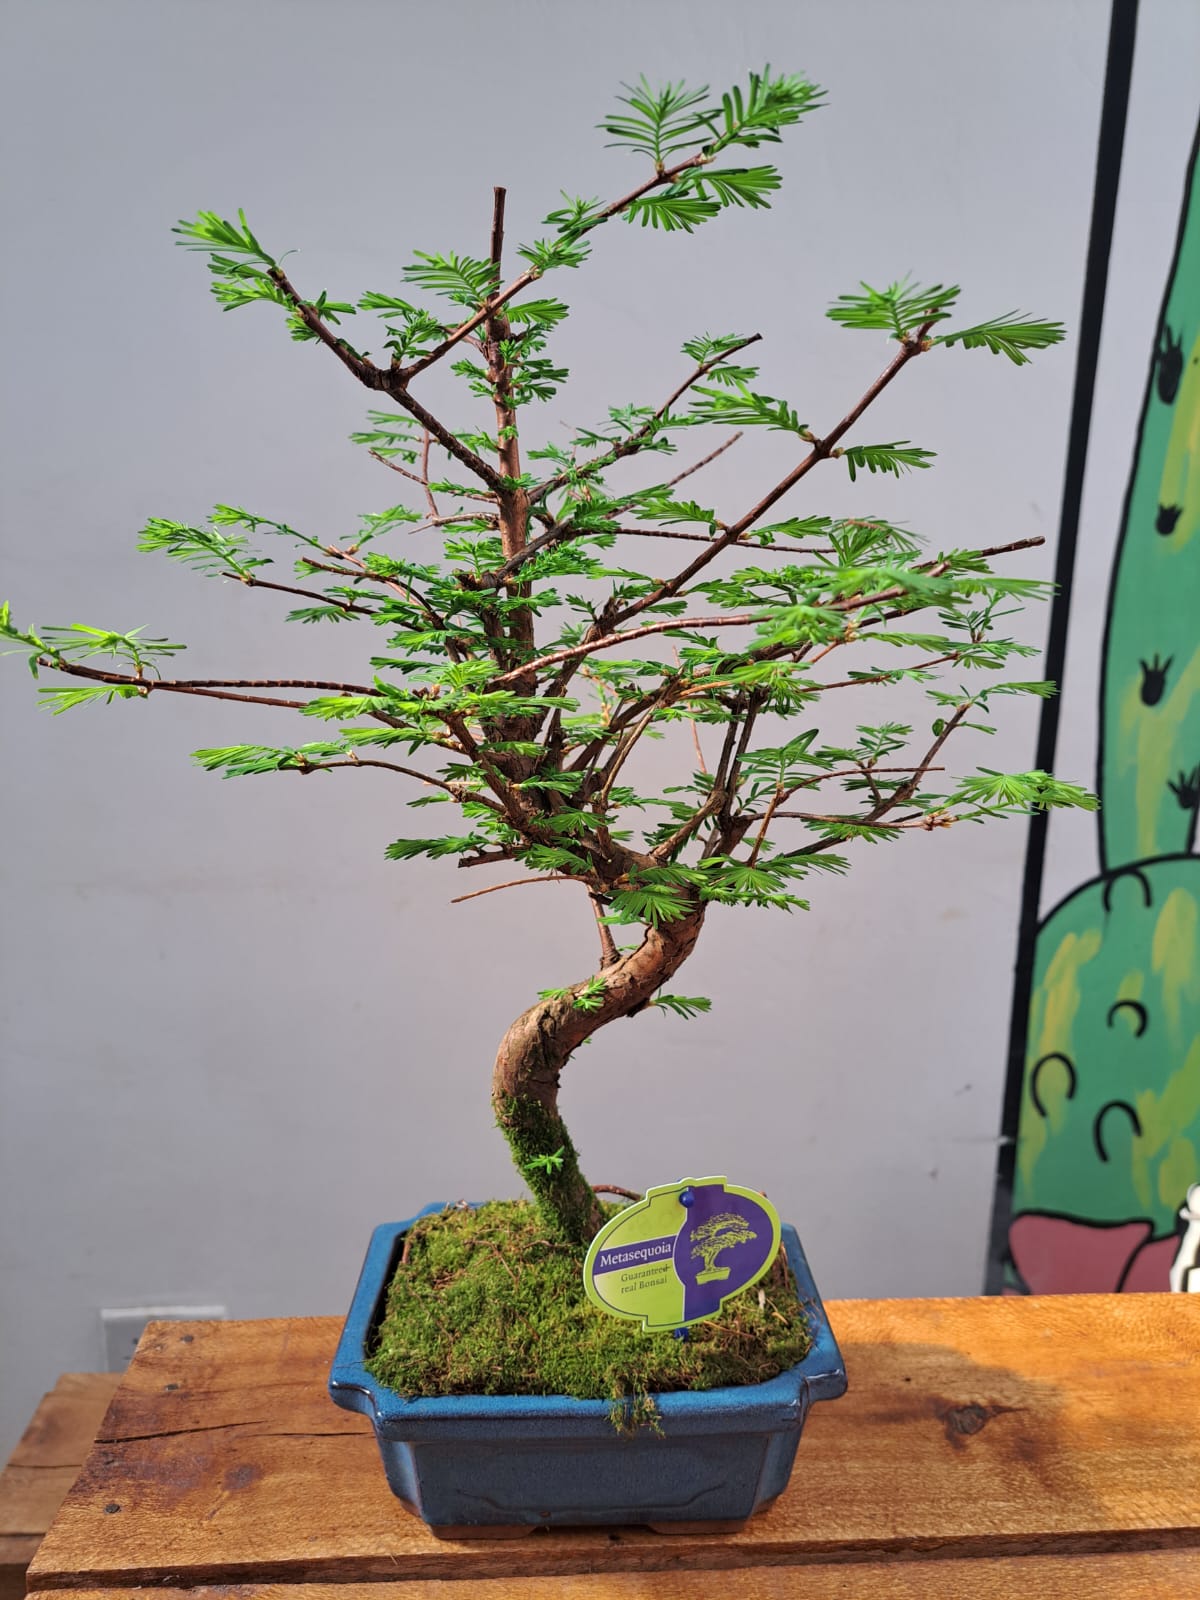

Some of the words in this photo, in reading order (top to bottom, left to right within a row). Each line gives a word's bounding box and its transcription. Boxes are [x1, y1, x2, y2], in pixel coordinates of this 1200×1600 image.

[600, 1242, 671, 1267] Metasequoia
[621, 1264, 669, 1282] Guaranteed
[620, 1281, 637, 1294] real
[639, 1276, 668, 1290] Bonsai
